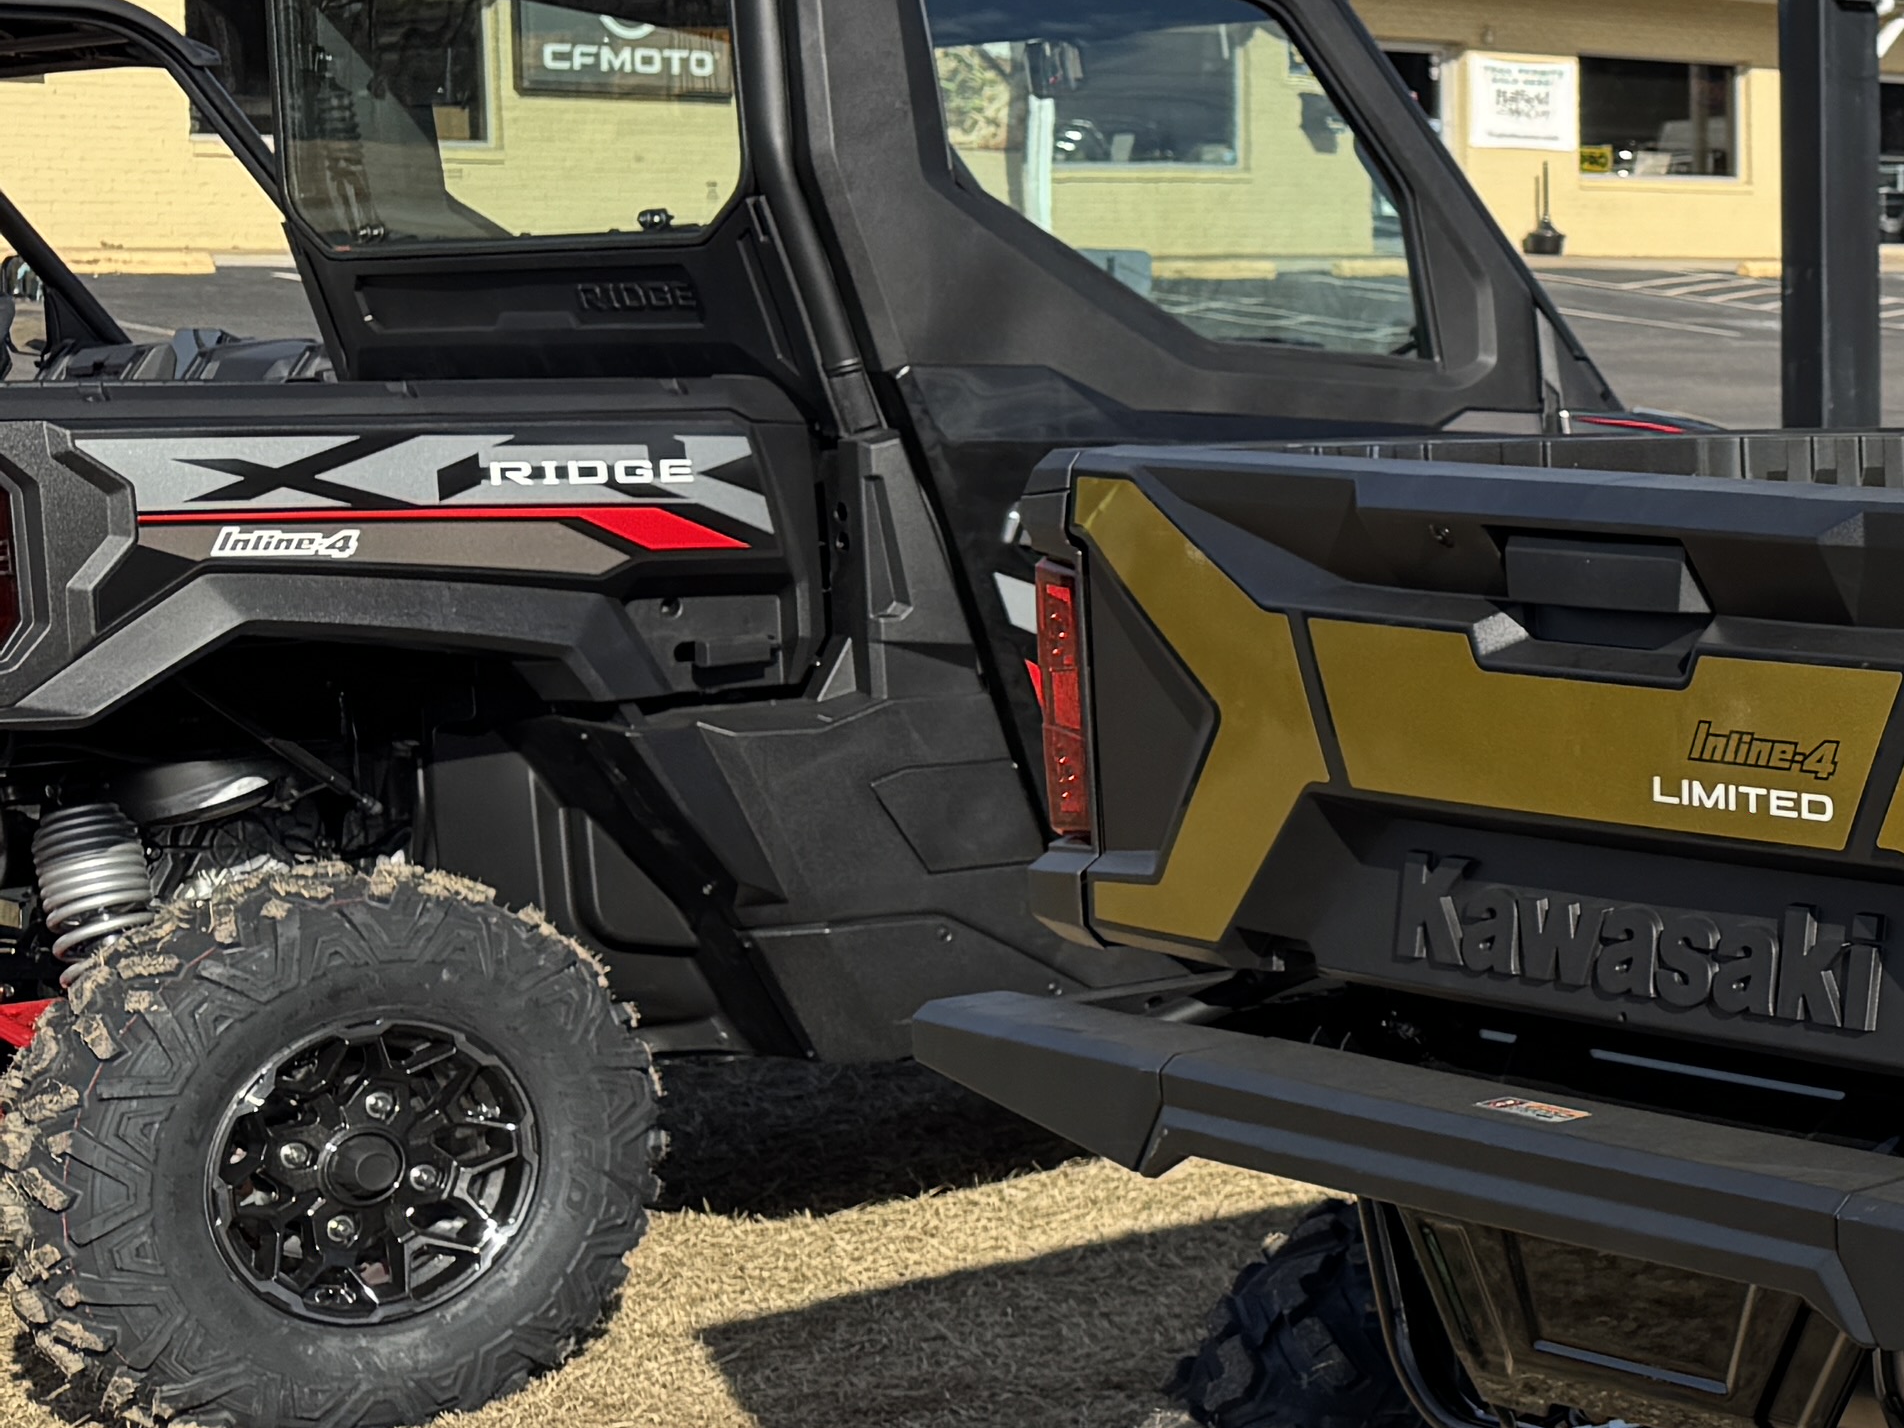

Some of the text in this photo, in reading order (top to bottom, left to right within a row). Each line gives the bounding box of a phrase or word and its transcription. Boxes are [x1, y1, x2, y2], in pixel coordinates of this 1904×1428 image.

[543, 42, 714, 77] CFMOTO
[576, 280, 698, 311] RIDGE
[488, 458, 696, 487] RIDGE
[210, 526, 361, 559] Inline-4
[1687, 719, 1842, 781] Inline-4
[1651, 774, 1835, 823] LIMITED
[1392, 849, 1887, 1034] Kawasaki
